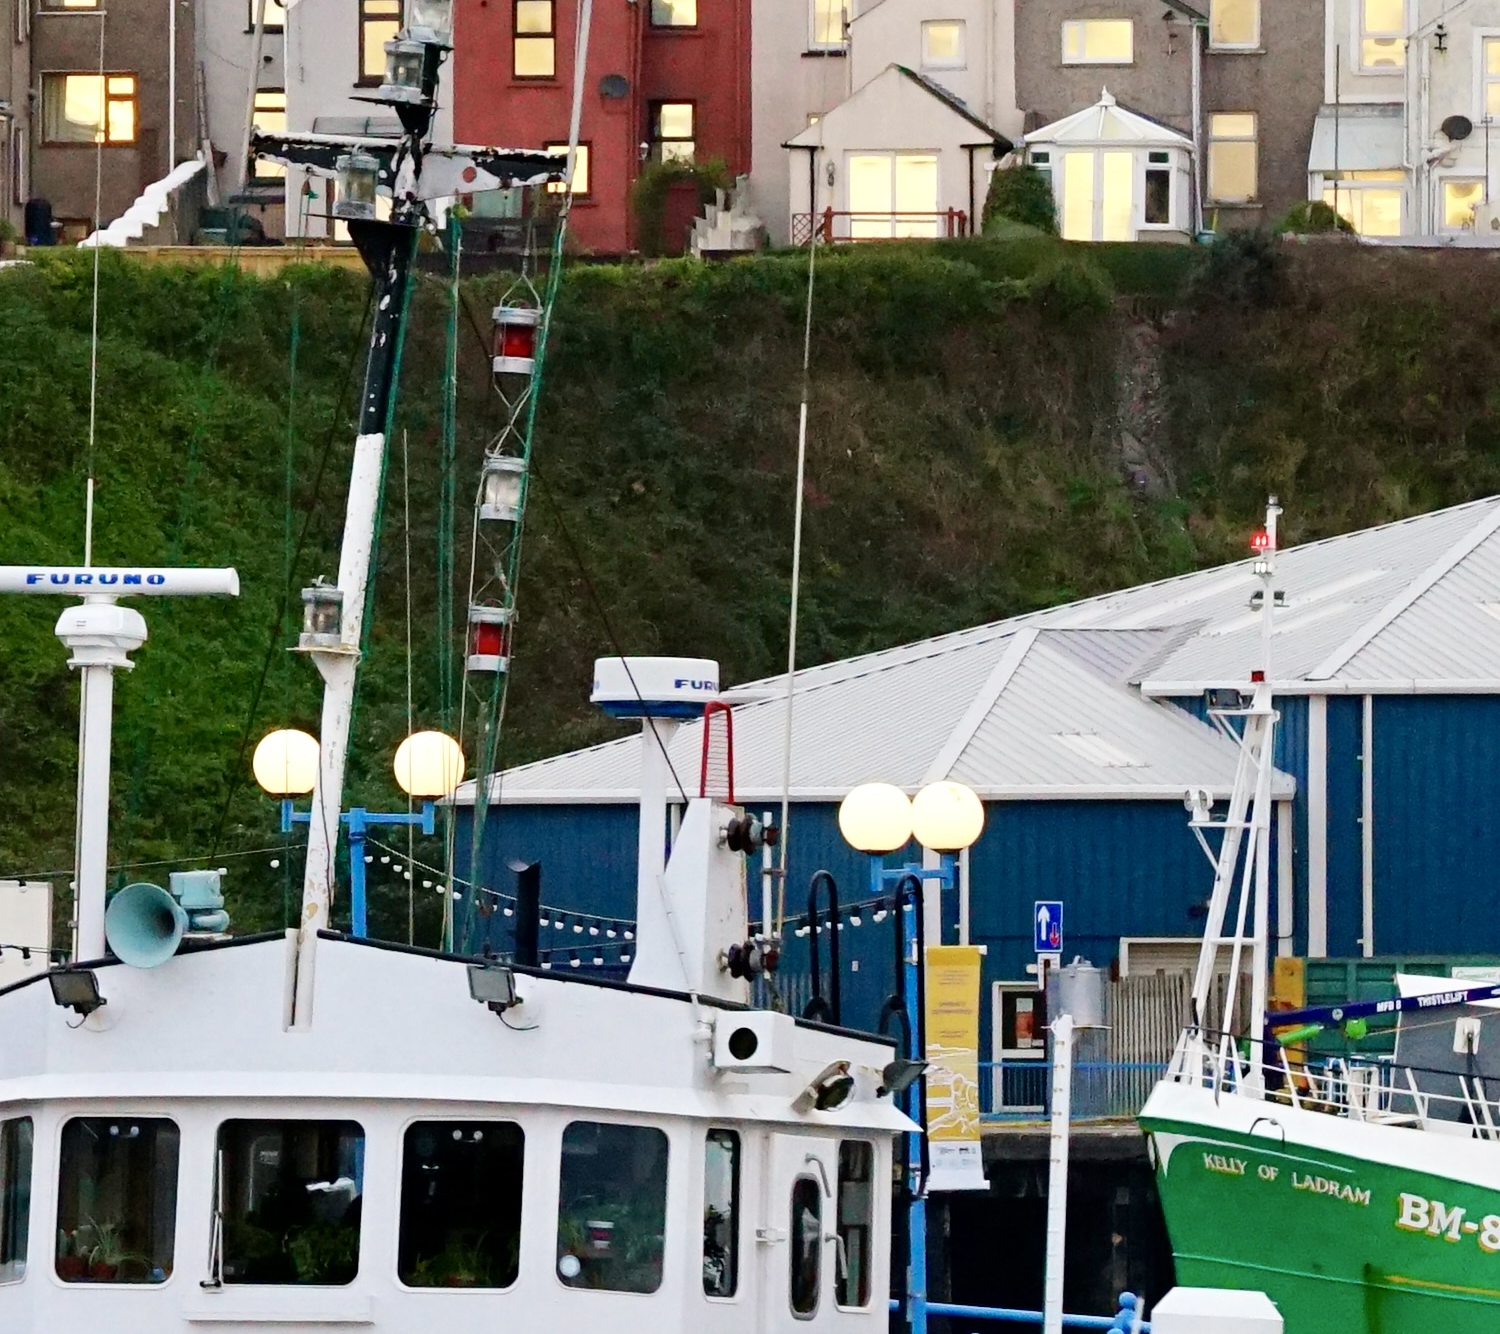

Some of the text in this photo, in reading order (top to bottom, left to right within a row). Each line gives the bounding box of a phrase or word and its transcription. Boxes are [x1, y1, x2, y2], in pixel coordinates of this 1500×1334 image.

[26, 573, 166, 585] FURUNO
[1203, 1152, 1372, 1207] KELLY OF LADRAM
